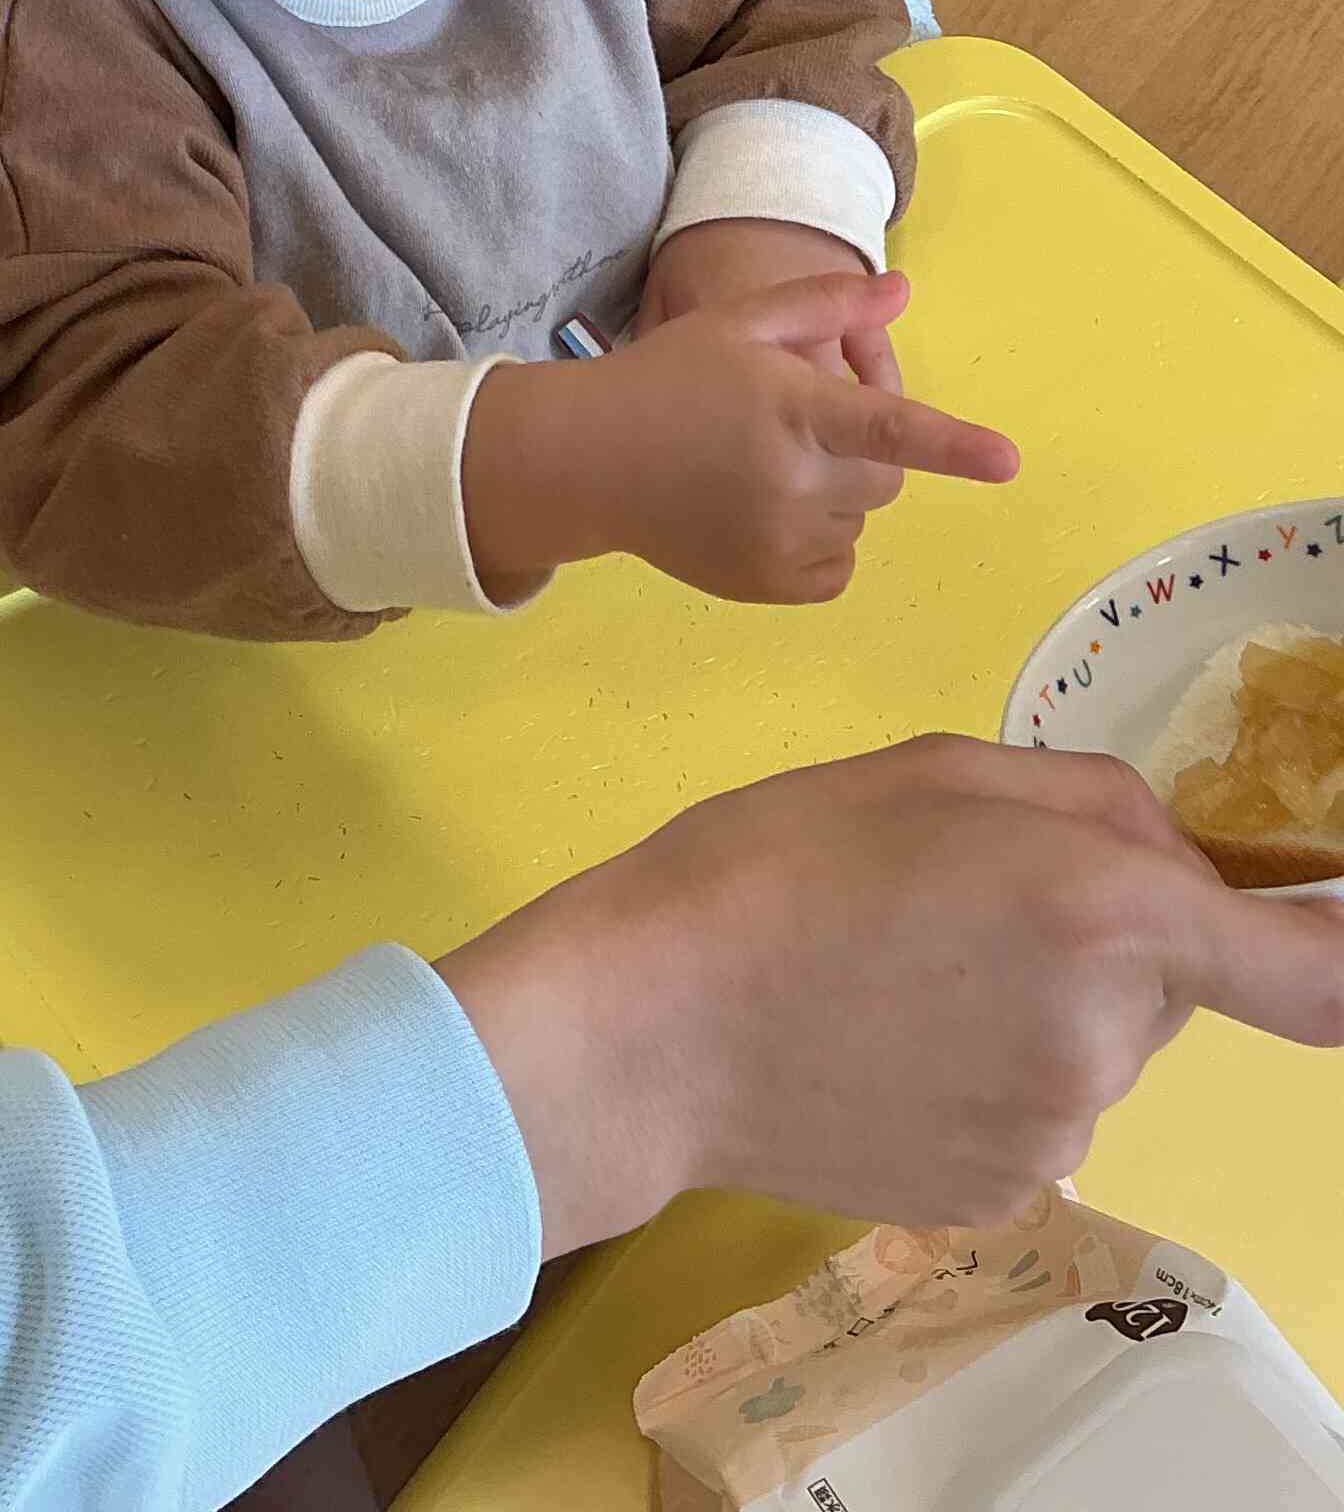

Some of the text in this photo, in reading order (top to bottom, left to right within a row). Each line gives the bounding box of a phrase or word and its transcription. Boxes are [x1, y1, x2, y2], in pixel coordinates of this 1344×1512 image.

[1039, 683, 1056, 711] T
[1073, 659, 1093, 688] U
[1100, 599, 1121, 627] V
[1147, 574, 1175, 604] W
[1209, 544, 1240, 576] X
[1277, 524, 1298, 549] Y
